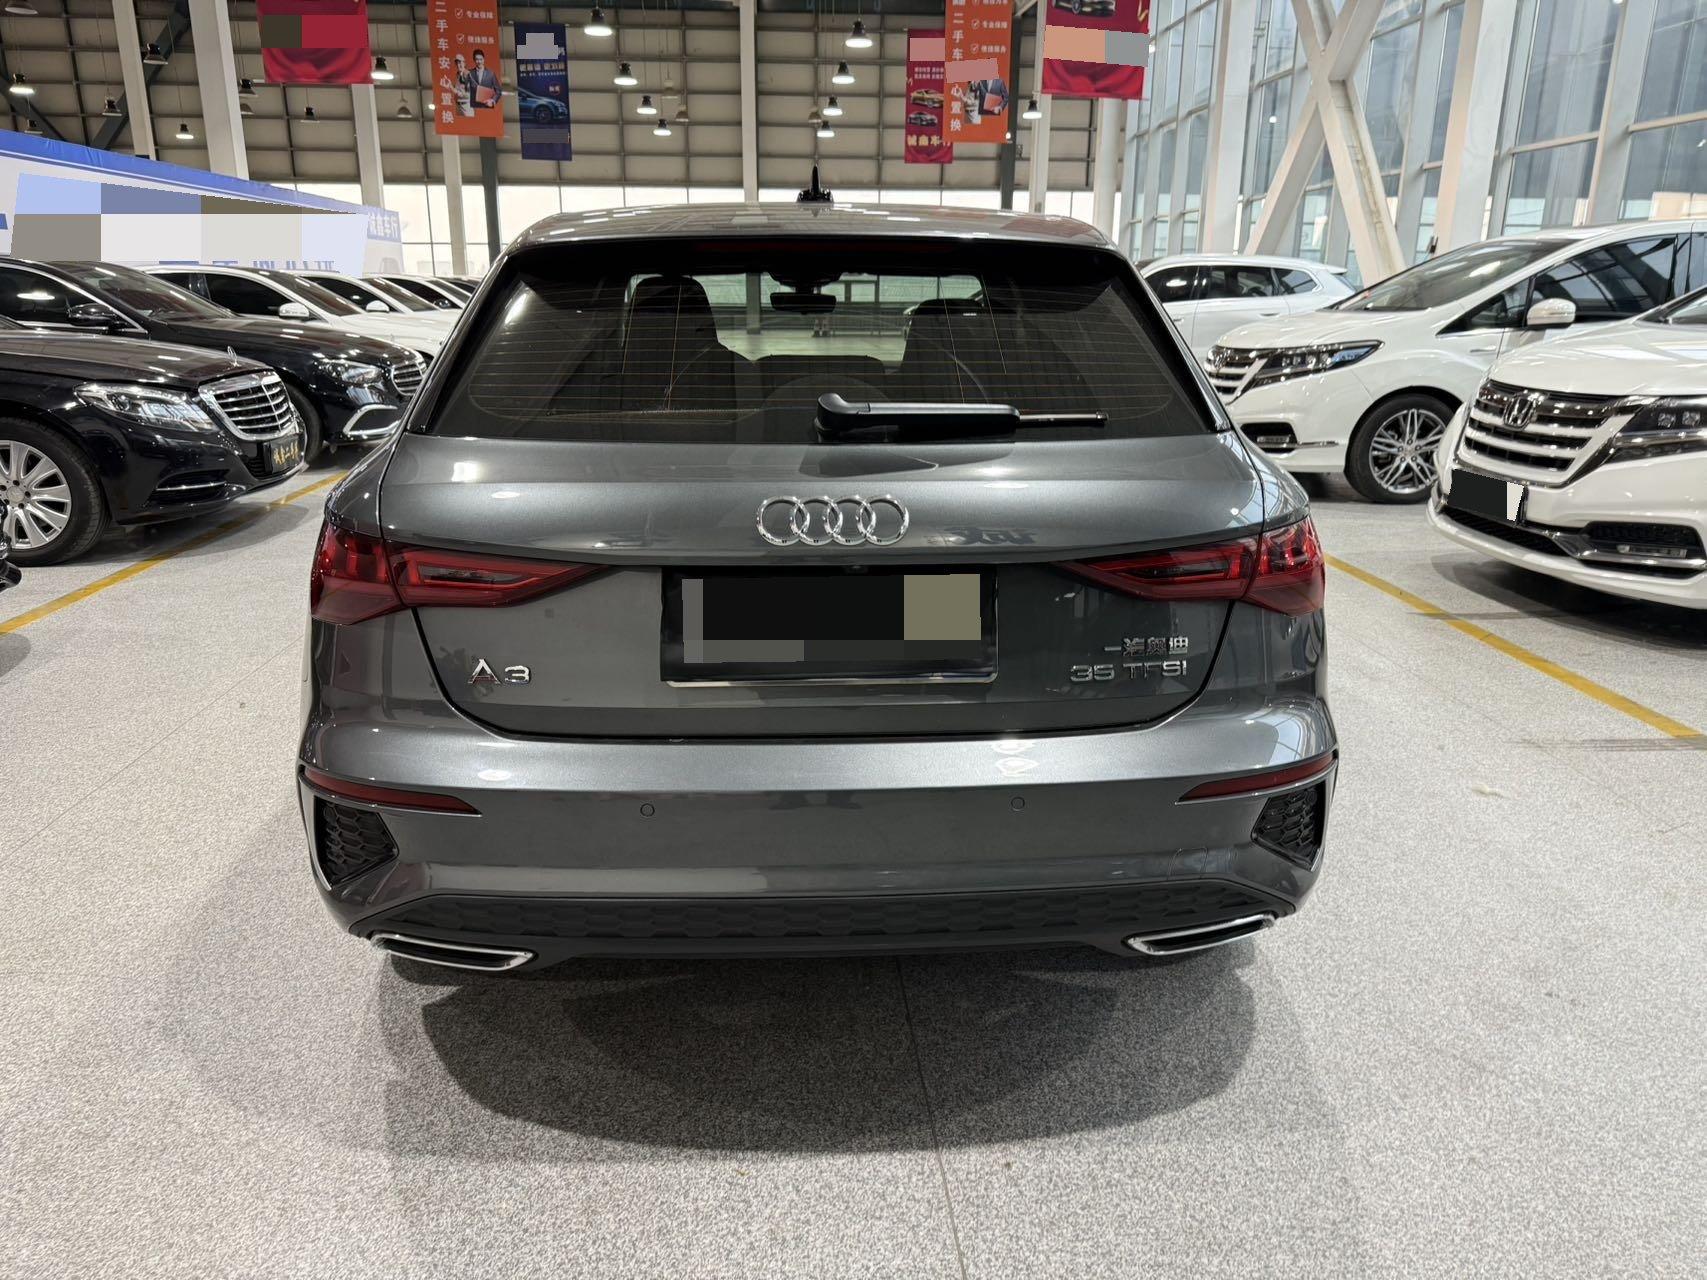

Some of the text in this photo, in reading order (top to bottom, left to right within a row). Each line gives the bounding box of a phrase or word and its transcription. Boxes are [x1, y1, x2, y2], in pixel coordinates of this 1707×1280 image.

[468, 658, 530, 685] A3
[1070, 660, 1187, 682] 35 TFSI
